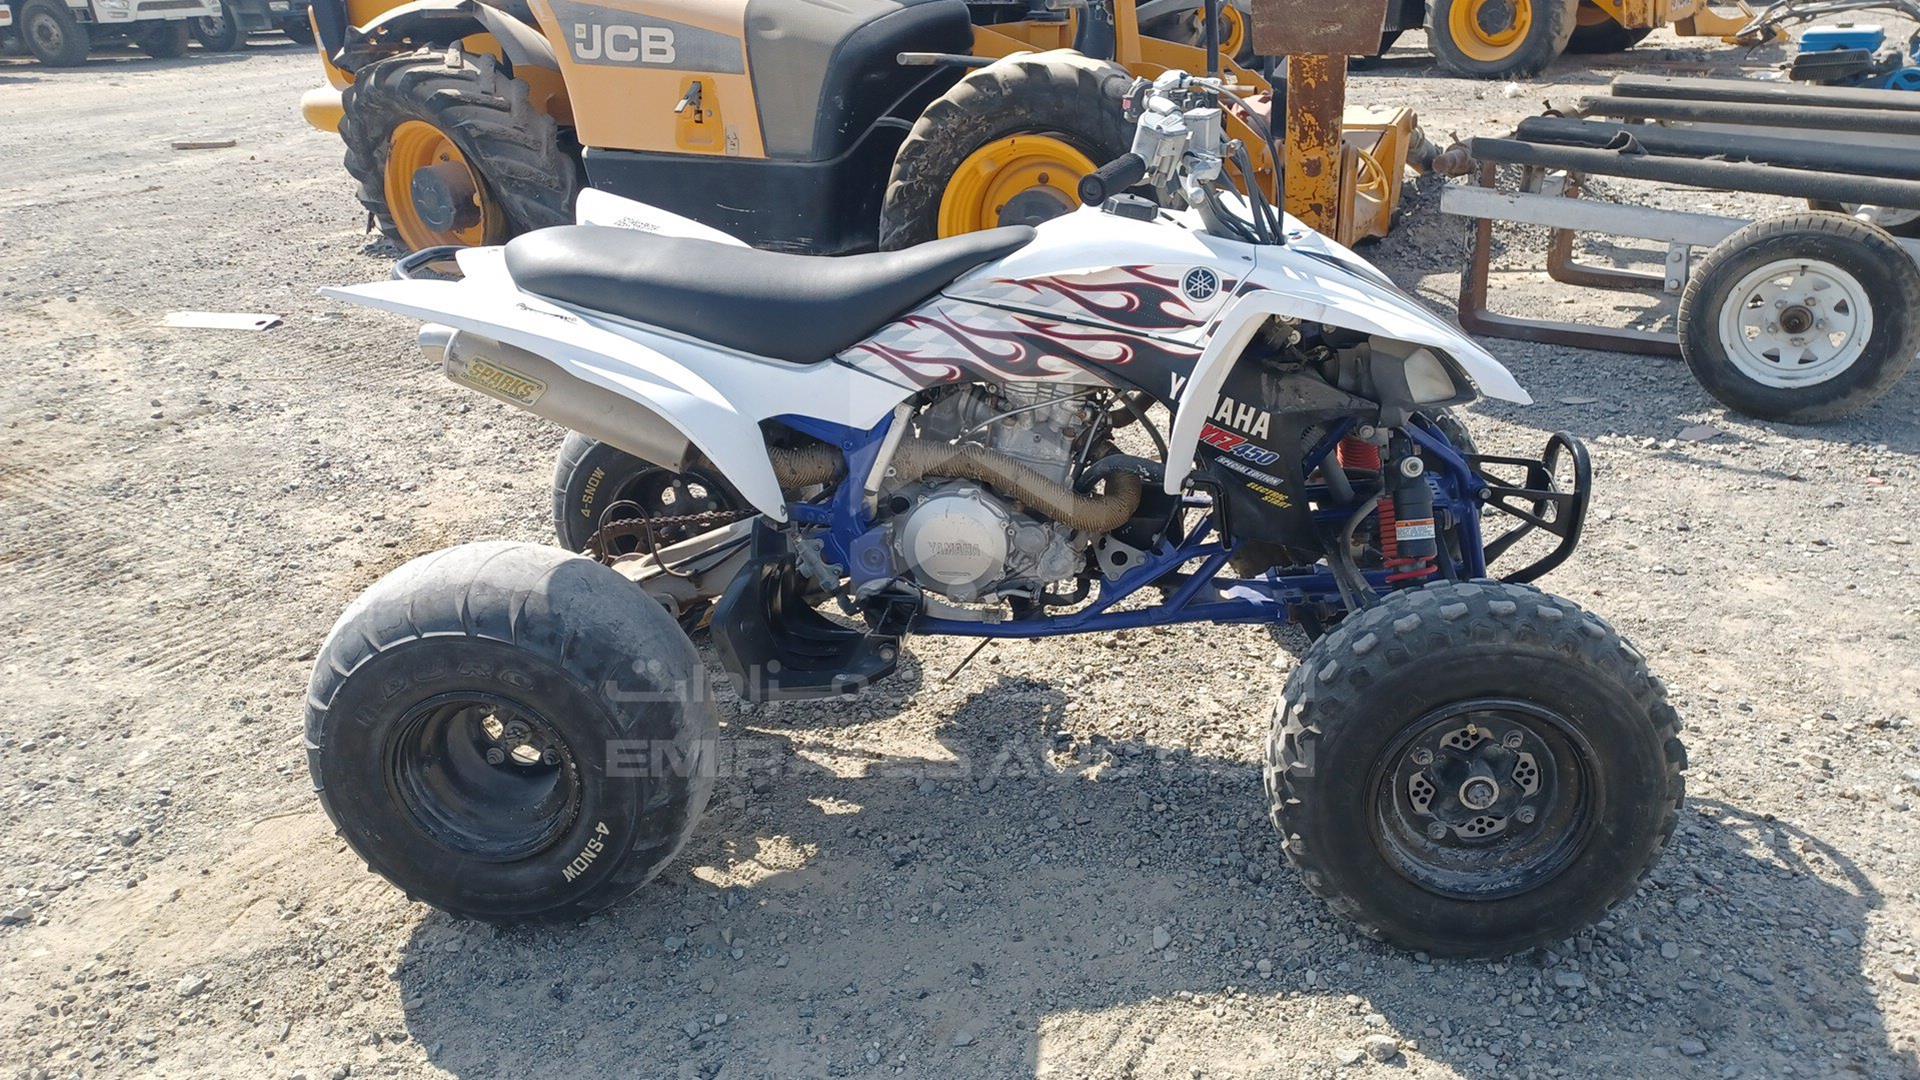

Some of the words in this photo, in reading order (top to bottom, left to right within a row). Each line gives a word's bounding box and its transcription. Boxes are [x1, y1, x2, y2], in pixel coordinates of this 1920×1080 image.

[575, 23, 676, 64] JCB
[470, 362, 535, 397] SPARKS
[1169, 371, 1271, 440] YAHA
[1217, 456, 1248, 476] SPECIAL
[1247, 468, 1280, 486] EDITION
[581, 466, 605, 518] 4-SNOW
[1246, 481, 1289, 501] ELECTRIC
[1261, 495, 1292, 509] START
[928, 541, 981, 557] YAMAHA
[562, 821, 610, 883] 4-SNOW
